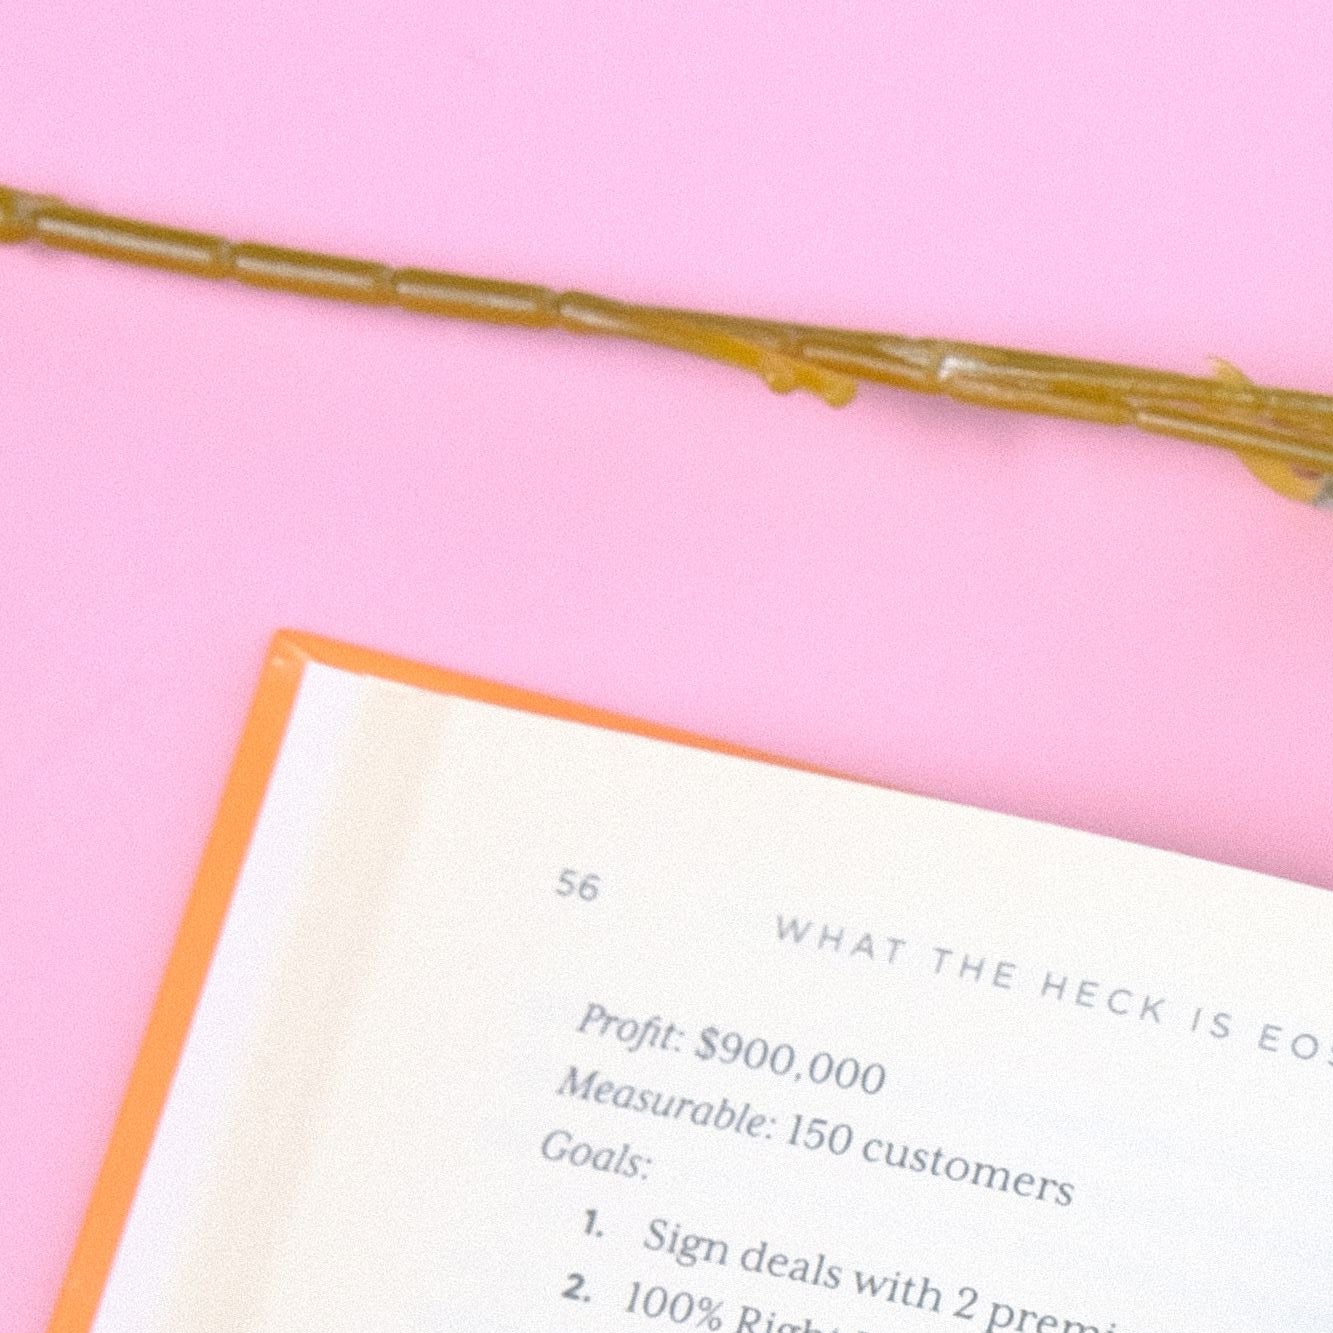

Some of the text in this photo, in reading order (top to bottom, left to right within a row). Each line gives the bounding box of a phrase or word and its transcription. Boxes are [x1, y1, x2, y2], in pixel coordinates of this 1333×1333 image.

[555, 868, 600, 902] 56
[777, 915, 906, 963] WHAT
[934, 947, 1016, 989] THE
[1041, 972, 1165, 1023] HECK
[1191, 1008, 1231, 1039] IS
[576, 1002, 887, 1095] Profit: $900,000
[540, 1129, 653, 1180] Goals:
[556, 1065, 1075, 1207] Measurable: 150 customers
[560, 1272, 591, 1304] 2.
[625, 1281, 723, 1332] 100%
[584, 1208, 604, 1238] 1.
[643, 1218, 729, 1267] Sign
[739, 1240, 843, 1290] deals
[854, 1270, 942, 1313] with
[953, 1286, 979, 1321] 2
